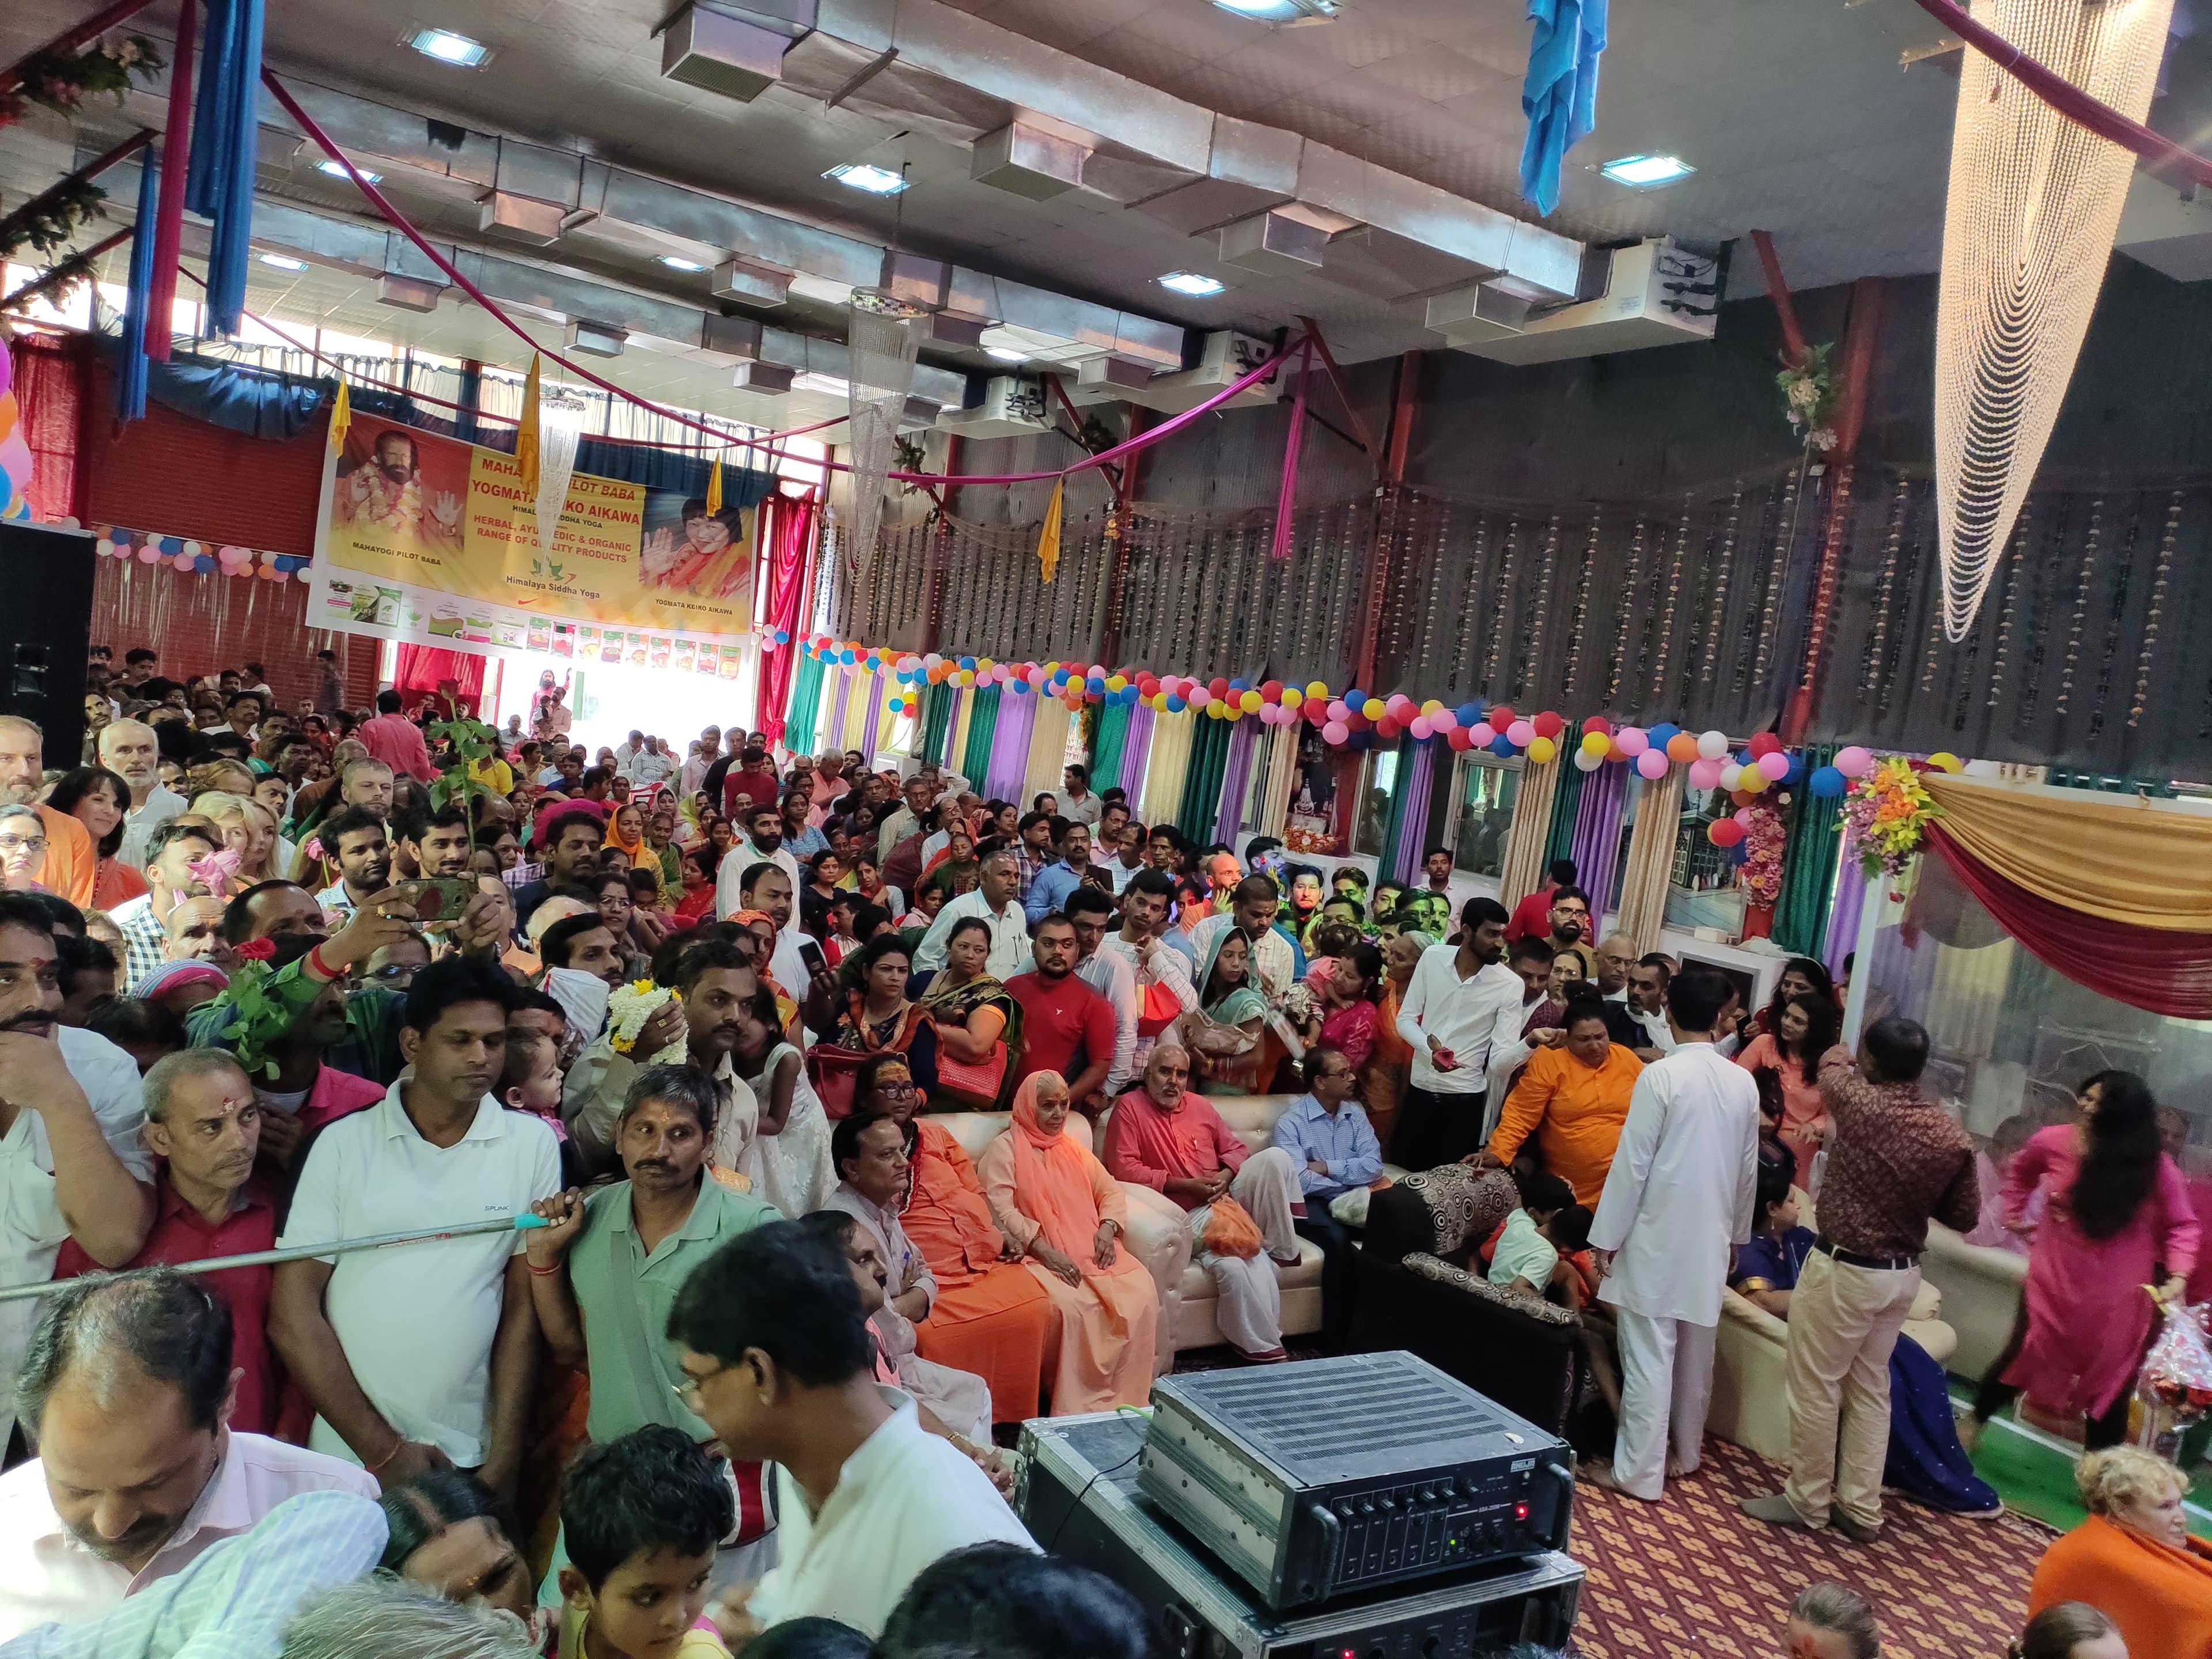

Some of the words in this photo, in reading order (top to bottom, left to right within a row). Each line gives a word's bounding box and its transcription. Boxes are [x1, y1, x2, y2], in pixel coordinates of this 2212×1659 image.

[568, 479, 598, 494] ILOT
[601, 485, 635, 501] BABA
[512, 505, 536, 516] HIMAL
[582, 519, 603, 528] YOGA
[588, 505, 640, 525] AIKAWA
[477, 528, 512, 541] RANGE
[515, 535, 528, 544] OF
[575, 547, 627, 562] PRODUCTS
[520, 524, 575, 541] AYUEDIC
[578, 535, 585, 543] &
[588, 537, 631, 551] ORGANIC
[353, 541, 394, 555] MAHAYOGI
[396, 551, 419, 560] PILOT
[421, 556, 441, 565] BABA
[506, 575, 546, 590] Himalaya
[548, 583, 577, 594] Siddha
[580, 588, 600, 599] Yoga
[655, 599, 685, 608] YOGMATA
[687, 603, 706, 611] KEIKO
[708, 607, 733, 615] AIKAWA
